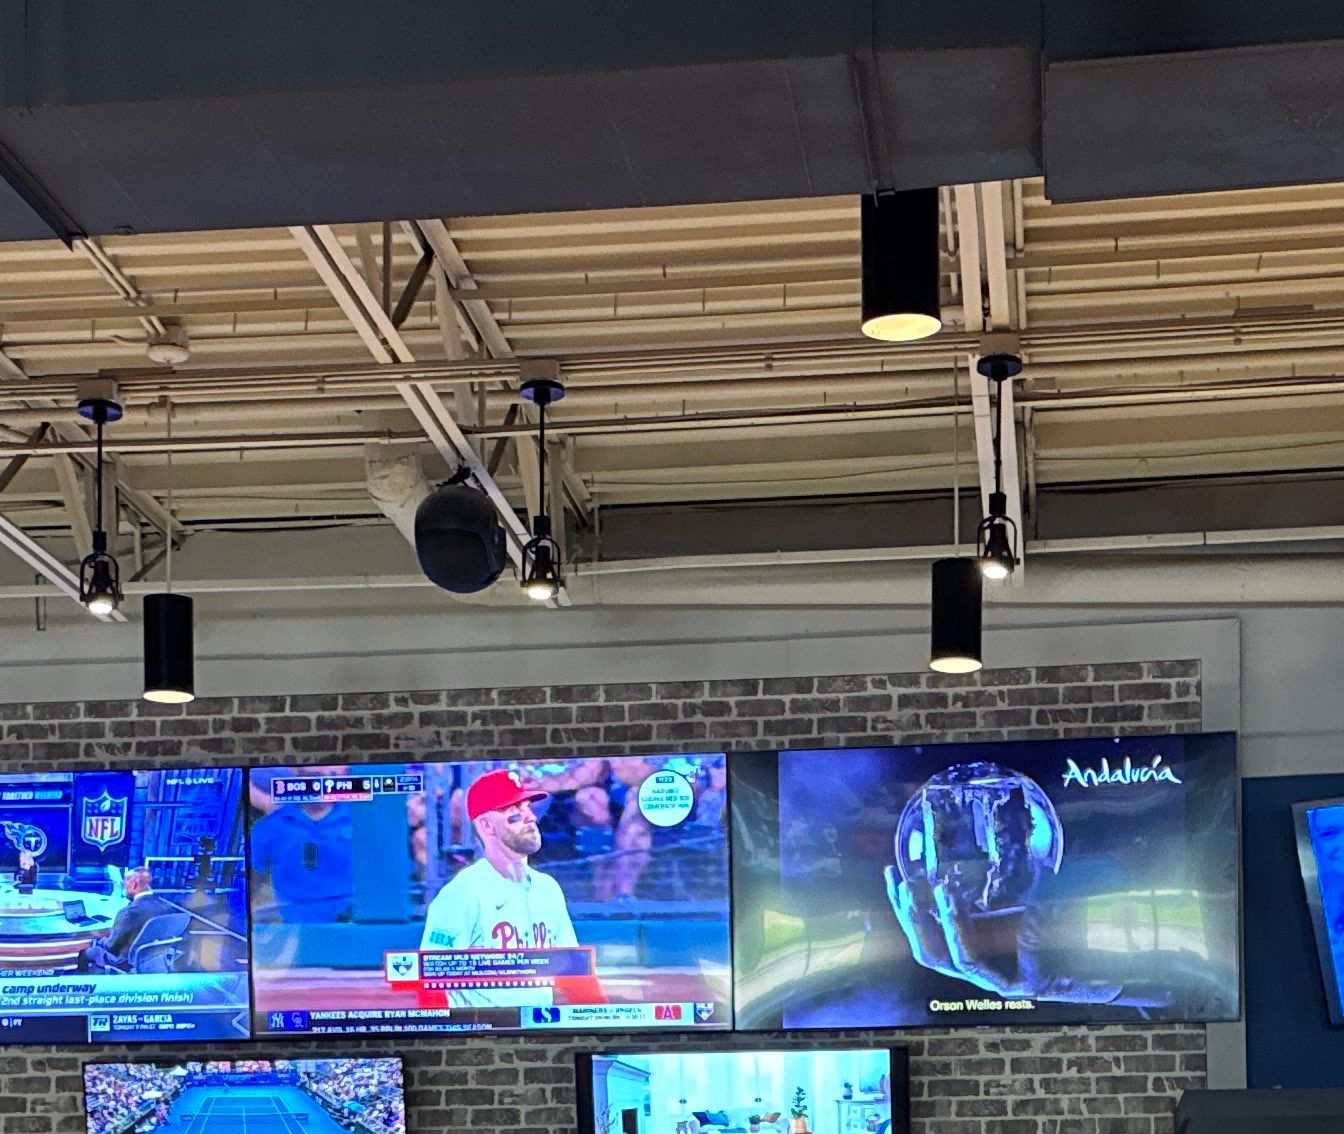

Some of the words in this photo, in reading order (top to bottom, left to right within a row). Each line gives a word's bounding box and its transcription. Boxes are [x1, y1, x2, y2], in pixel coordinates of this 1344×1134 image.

[1062, 756, 1183, 788] Andalucía
[287, 782, 306, 791] BOS
[312, 781, 321, 791] 0
[336, 781, 353, 790] PHI
[362, 780, 371, 789] 5
[88, 817, 119, 838] NFL
[2, 985, 35, 997] camp
[36, 983, 97, 995] underway
[23, 995, 64, 1007] straight
[118, 993, 159, 1003] division
[930, 1000, 962, 1012] Orson
[965, 999, 1001, 1011] Welles
[310, 1011, 346, 1020] YANKEES
[348, 1010, 383, 1019] ACQUIRE
